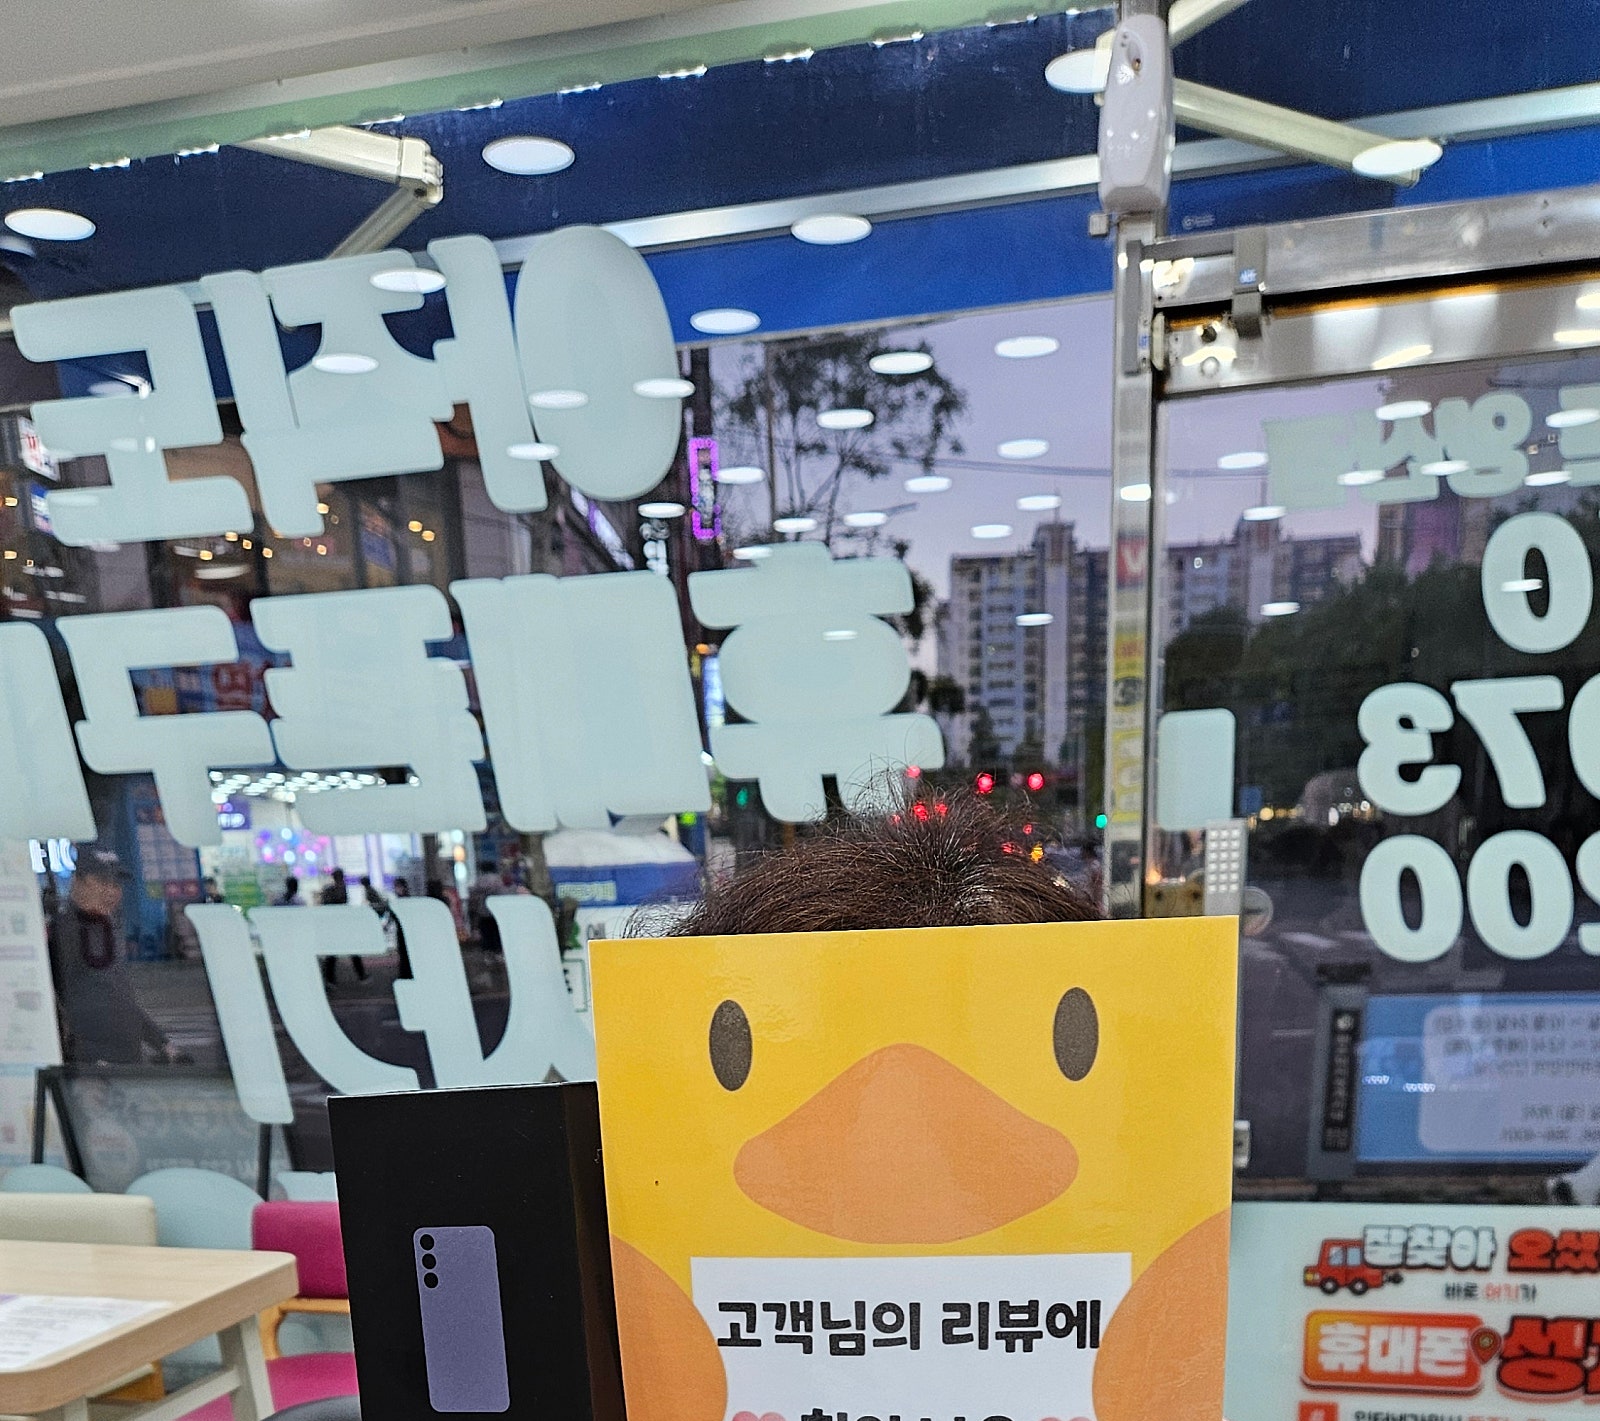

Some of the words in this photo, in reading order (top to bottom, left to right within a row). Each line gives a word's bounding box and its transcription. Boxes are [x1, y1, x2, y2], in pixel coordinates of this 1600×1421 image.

[1363, 1223, 1497, 1271] 잘찾아
[716, 1300, 921, 1356] 고객님의
[941, 1299, 1101, 1353] 리뷰에
[1318, 1322, 1469, 1377] 휴대폰
[1497, 1315, 1600, 1395] 성
